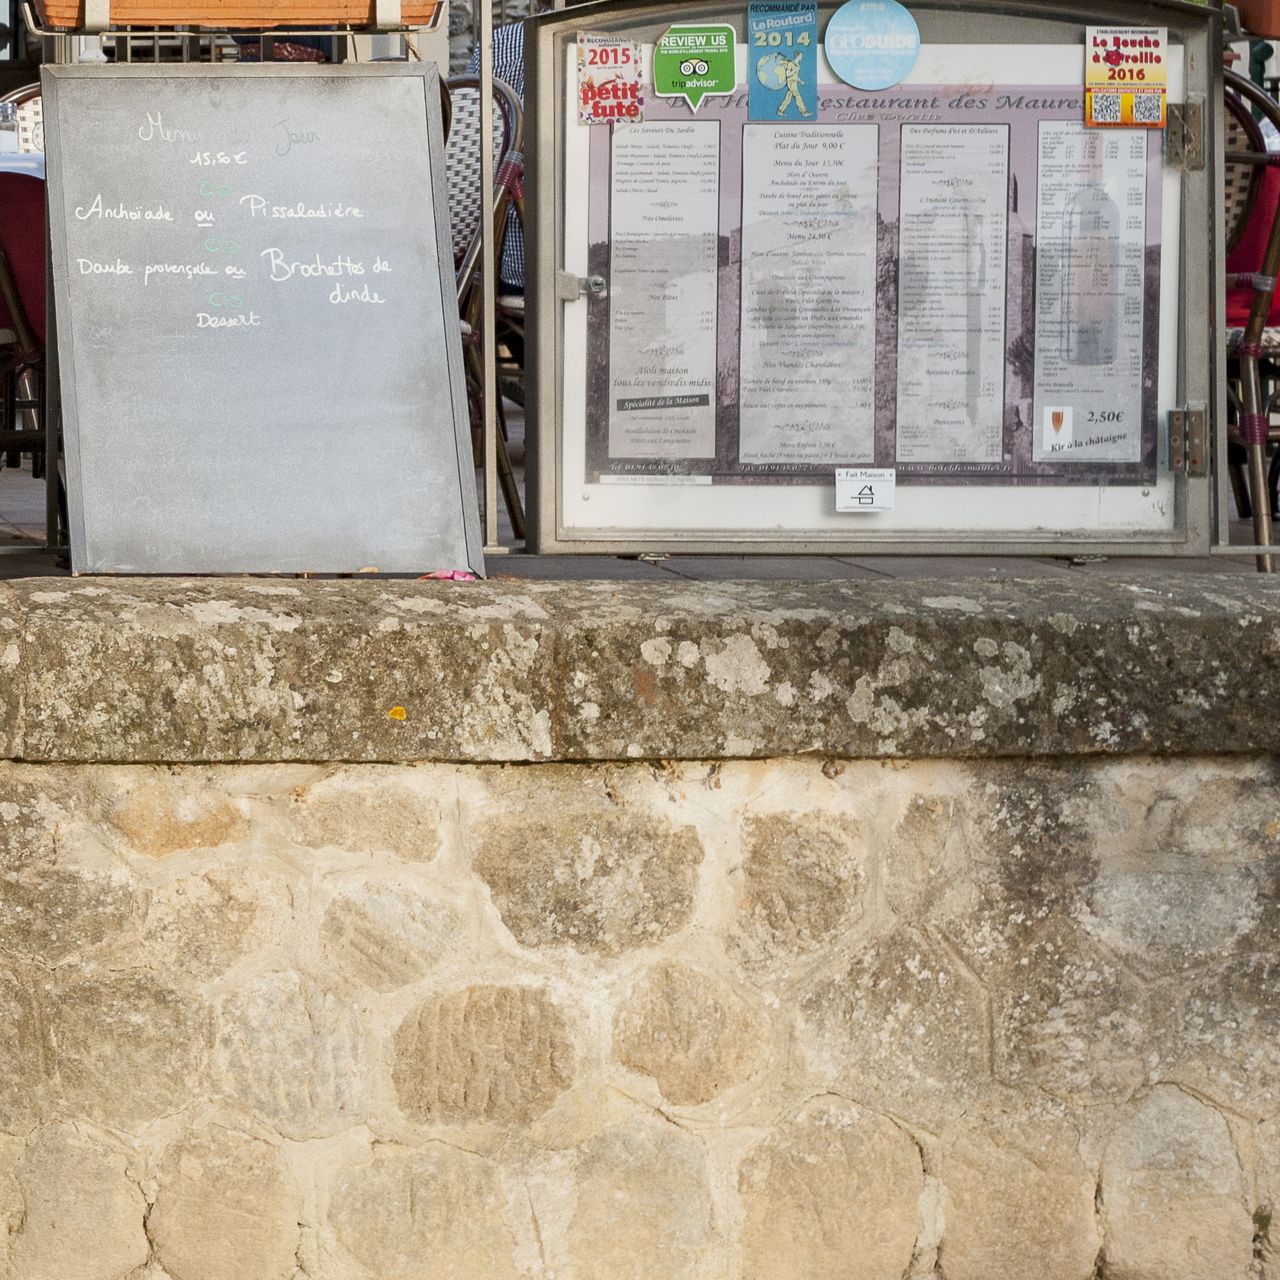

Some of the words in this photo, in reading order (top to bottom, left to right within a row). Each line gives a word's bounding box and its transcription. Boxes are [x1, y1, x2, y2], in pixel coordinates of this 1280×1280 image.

[750, 2, 799, 12] RECOMMANDÉ
[801, 3, 815, 12] PAR
[767, 13, 813, 28] Routard
[661, 36, 707, 46] REVIEW
[711, 35, 727, 45] US
[754, 32, 811, 47] 2014
[588, 47, 631, 65] 2015
[1108, 69, 1145, 80] 2016
[672, 79, 717, 88] tripadvisor
[582, 80, 639, 105] petit
[592, 98, 640, 118] futé
[817, 95, 941, 110] estaurant
[948, 94, 988, 109] des
[800, 130, 844, 138] Traditionnelle
[75, 194, 173, 221] Anchoïade
[194, 210, 215, 225] ou
[77, 258, 133, 275] Daube
[144, 260, 218, 286] provençale
[225, 266, 246, 278] ou
[260, 247, 365, 282] Brochettes
[372, 256, 392, 274] de
[329, 283, 386, 305] dinde
[196, 313, 260, 328] Dessert
[634, 378, 645, 386] les
[688, 378, 711, 386] midis
[624, 400, 656, 410] Spécialité
[1087, 411, 1124, 424] 2,50€
[1051, 443, 1065, 452] Kir
[1074, 439, 1083, 448] la
[1086, 432, 1127, 447] châtaigne
